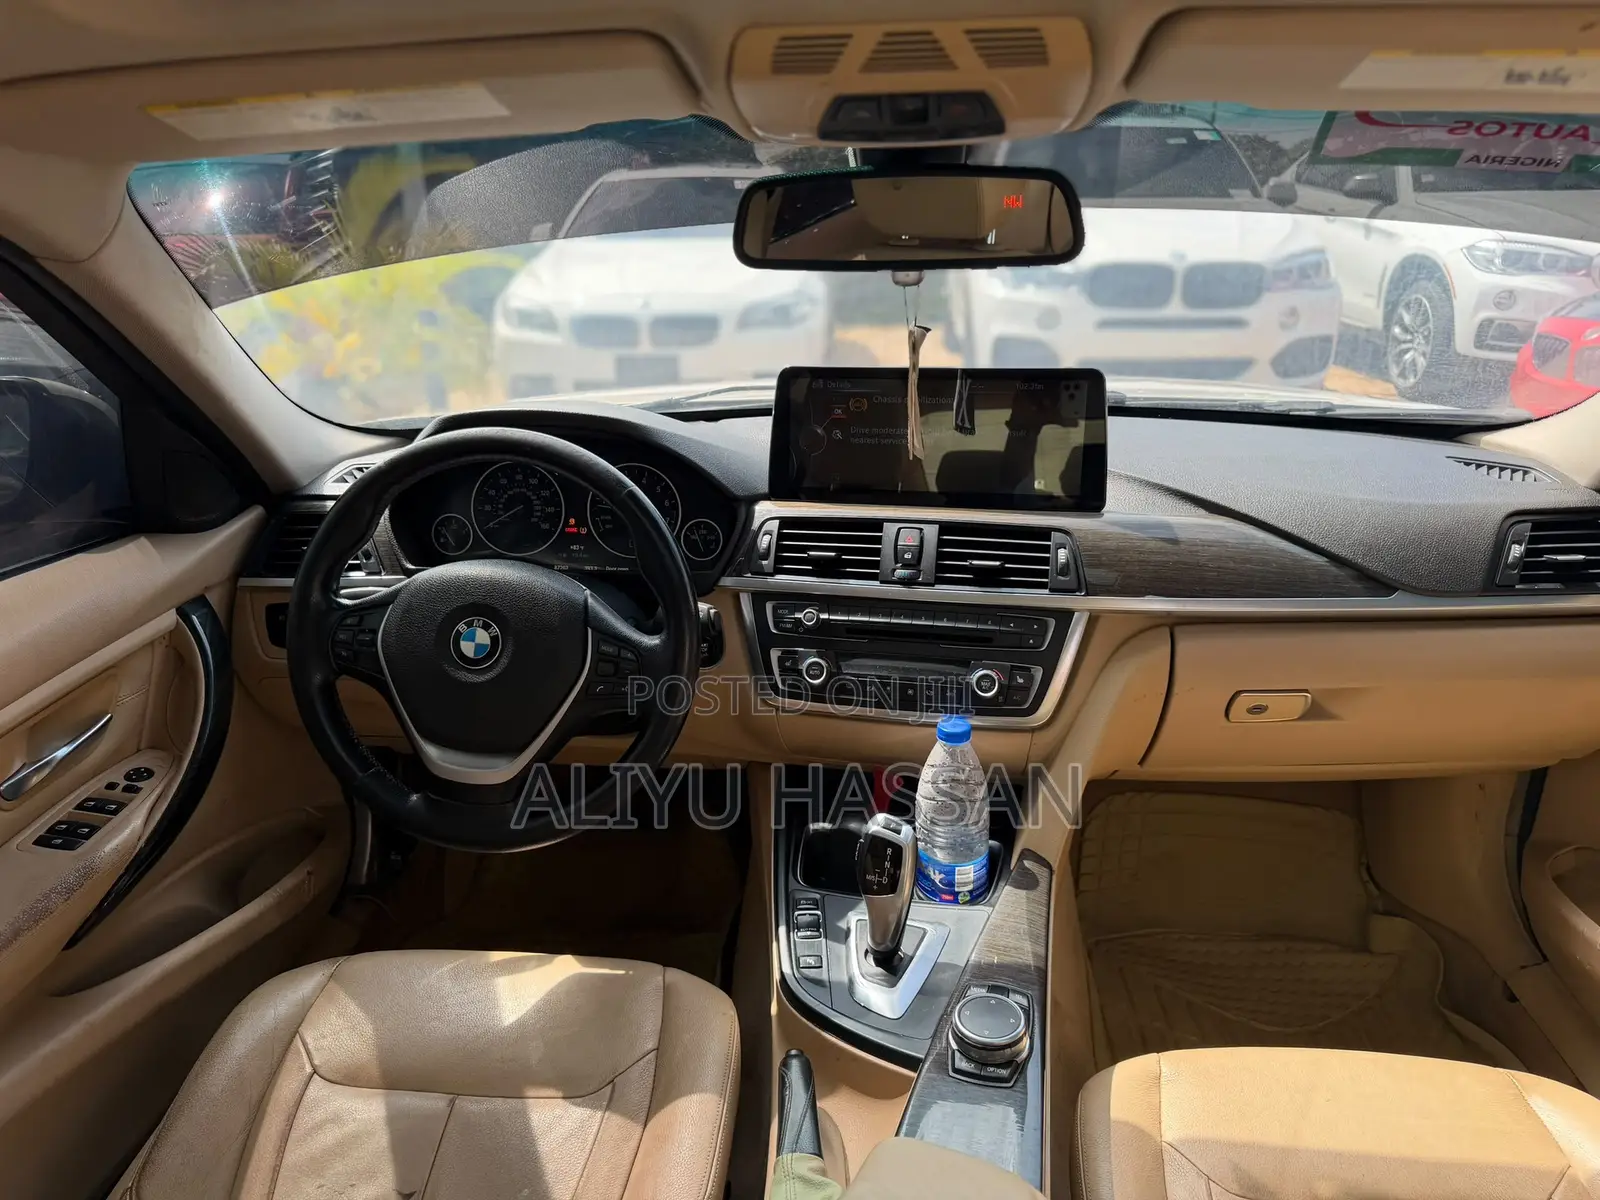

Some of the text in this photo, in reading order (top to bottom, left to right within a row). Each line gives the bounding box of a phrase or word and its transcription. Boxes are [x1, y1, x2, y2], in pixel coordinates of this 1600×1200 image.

[458, 619, 498, 637] BMW
[886, 847, 892, 856] R
[884, 861, 891, 869] N
[882, 876, 888, 884] D
[986, 1067, 1007, 1075] OPTION
